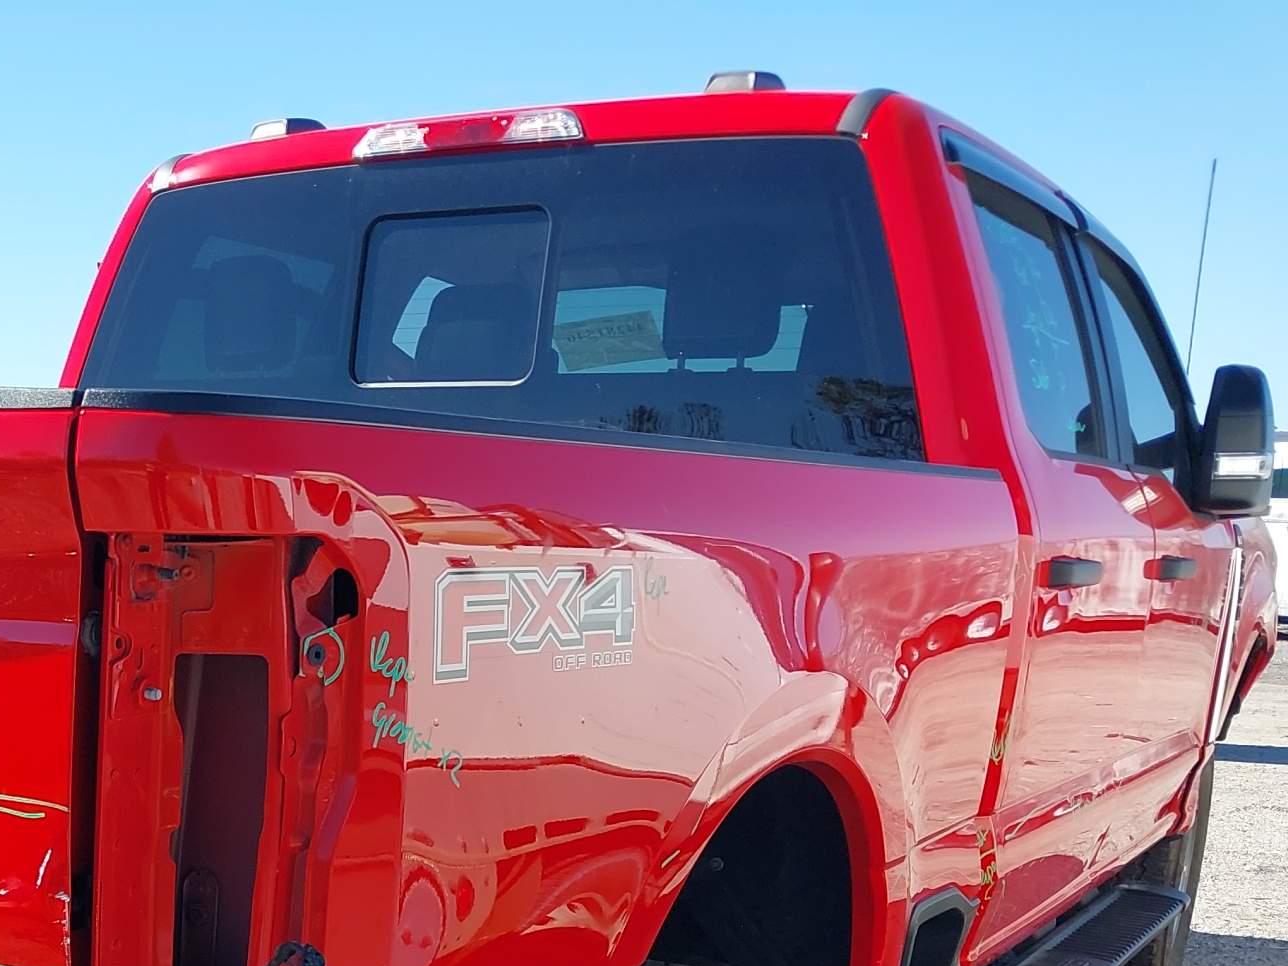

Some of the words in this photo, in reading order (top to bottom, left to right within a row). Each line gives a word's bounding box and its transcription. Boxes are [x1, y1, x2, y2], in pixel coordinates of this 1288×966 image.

[433, 565, 635, 684] FX4
[552, 653, 587, 672] OFF
[591, 650, 633, 668] ROAD
